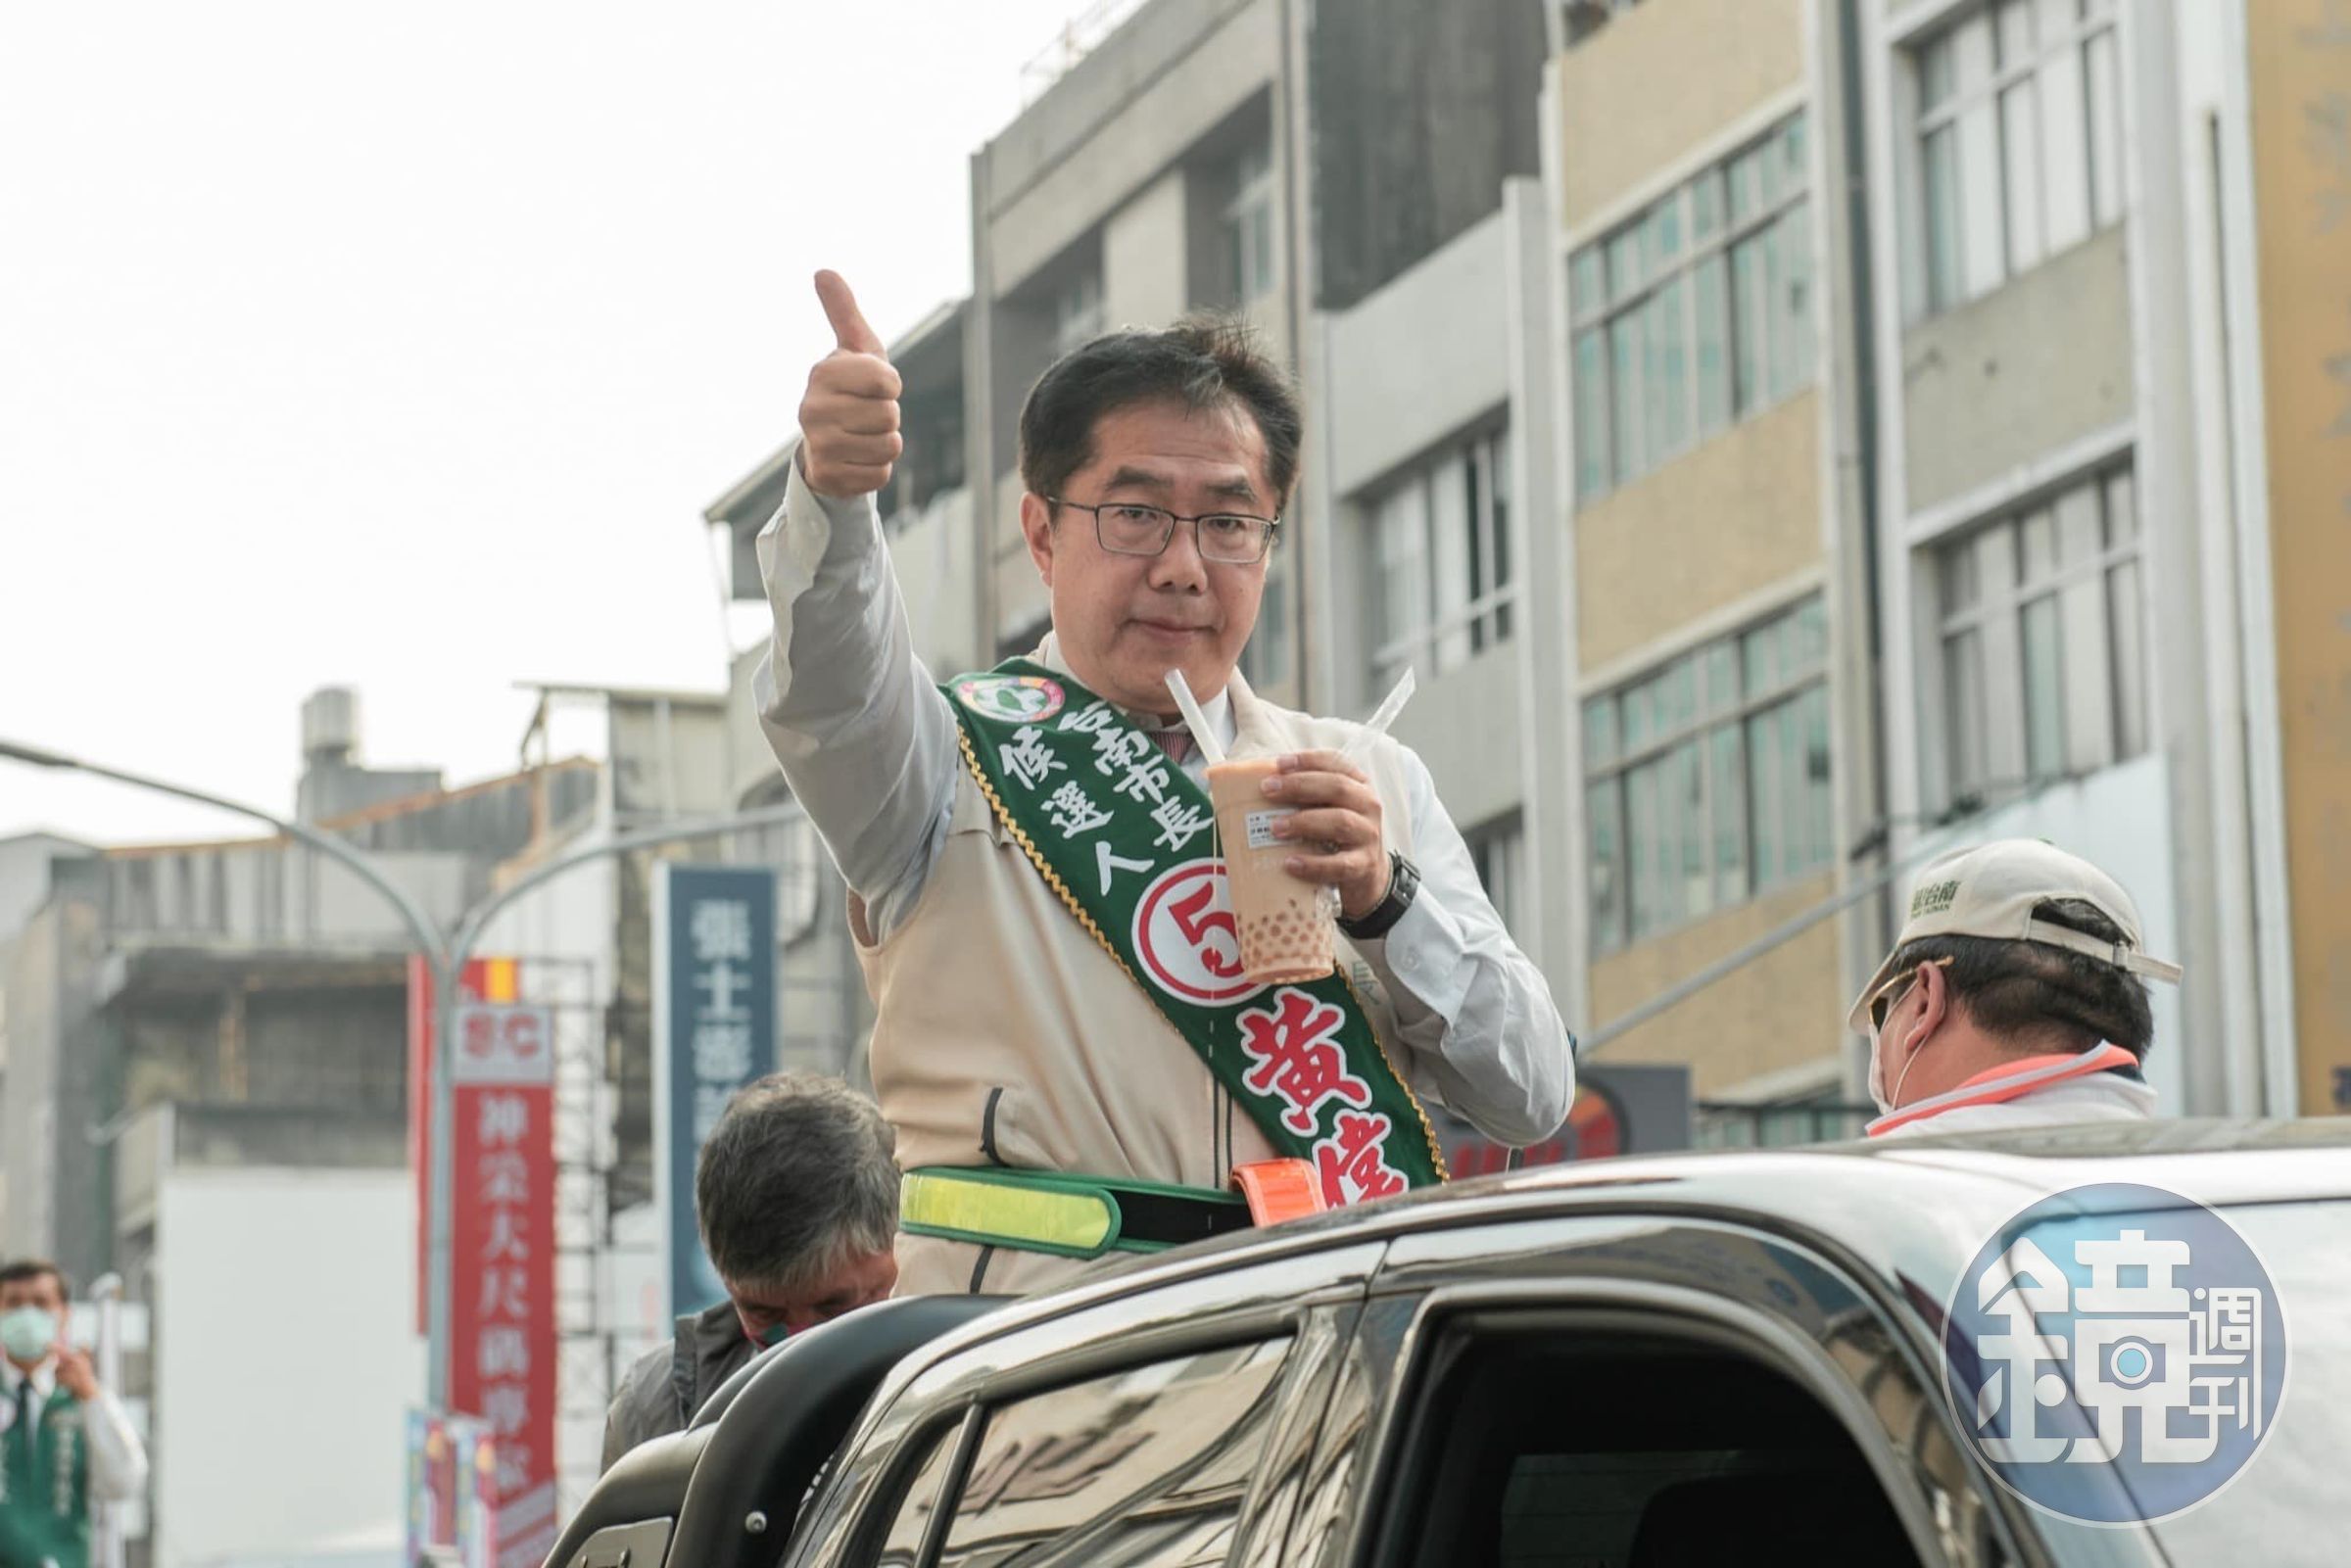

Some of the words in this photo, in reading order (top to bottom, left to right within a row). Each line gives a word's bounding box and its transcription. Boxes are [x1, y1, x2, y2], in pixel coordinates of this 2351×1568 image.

[998, 726, 1156, 898] 候選人
[1057, 699, 1216, 853] 台南市長
[1168, 880, 1245, 978] 5
